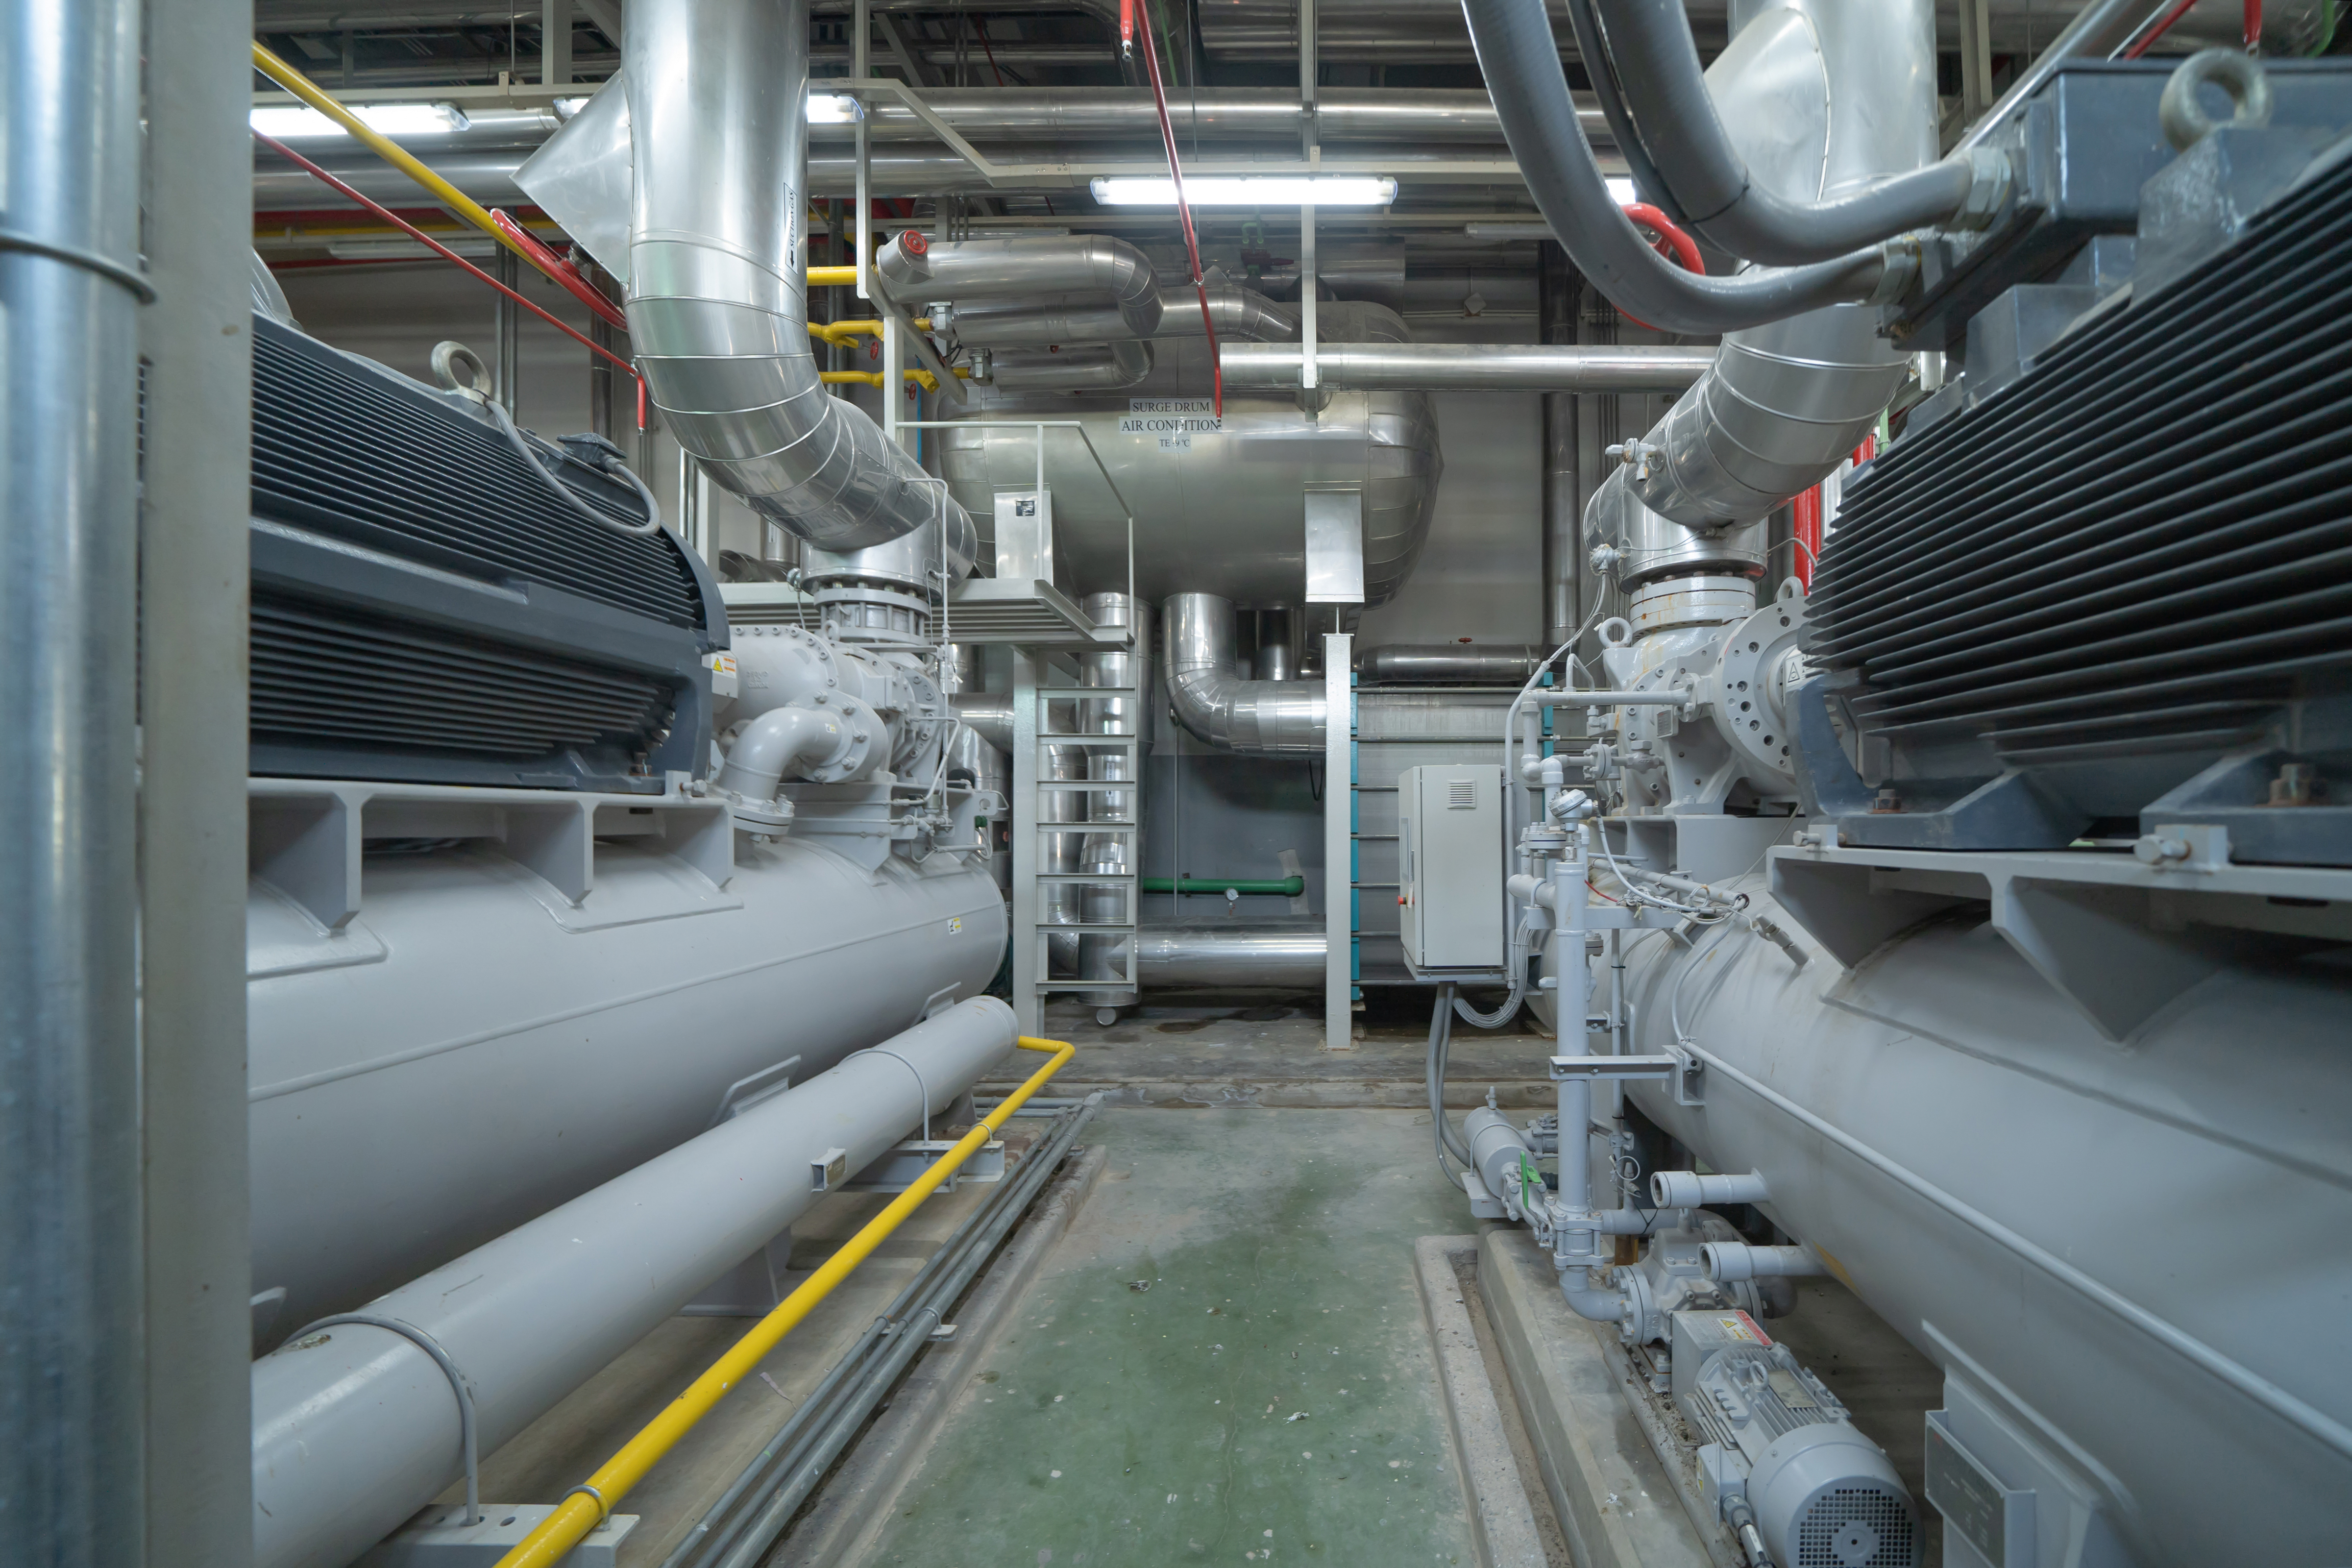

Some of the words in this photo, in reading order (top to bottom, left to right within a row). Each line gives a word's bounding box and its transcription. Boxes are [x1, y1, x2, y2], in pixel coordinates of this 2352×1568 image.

[1133, 402, 1171, 412] SURGE
[1175, 402, 1210, 412] DRUM
[1122, 420, 1144, 431] AIR
[1147, 420, 1220, 431] CONDITION
